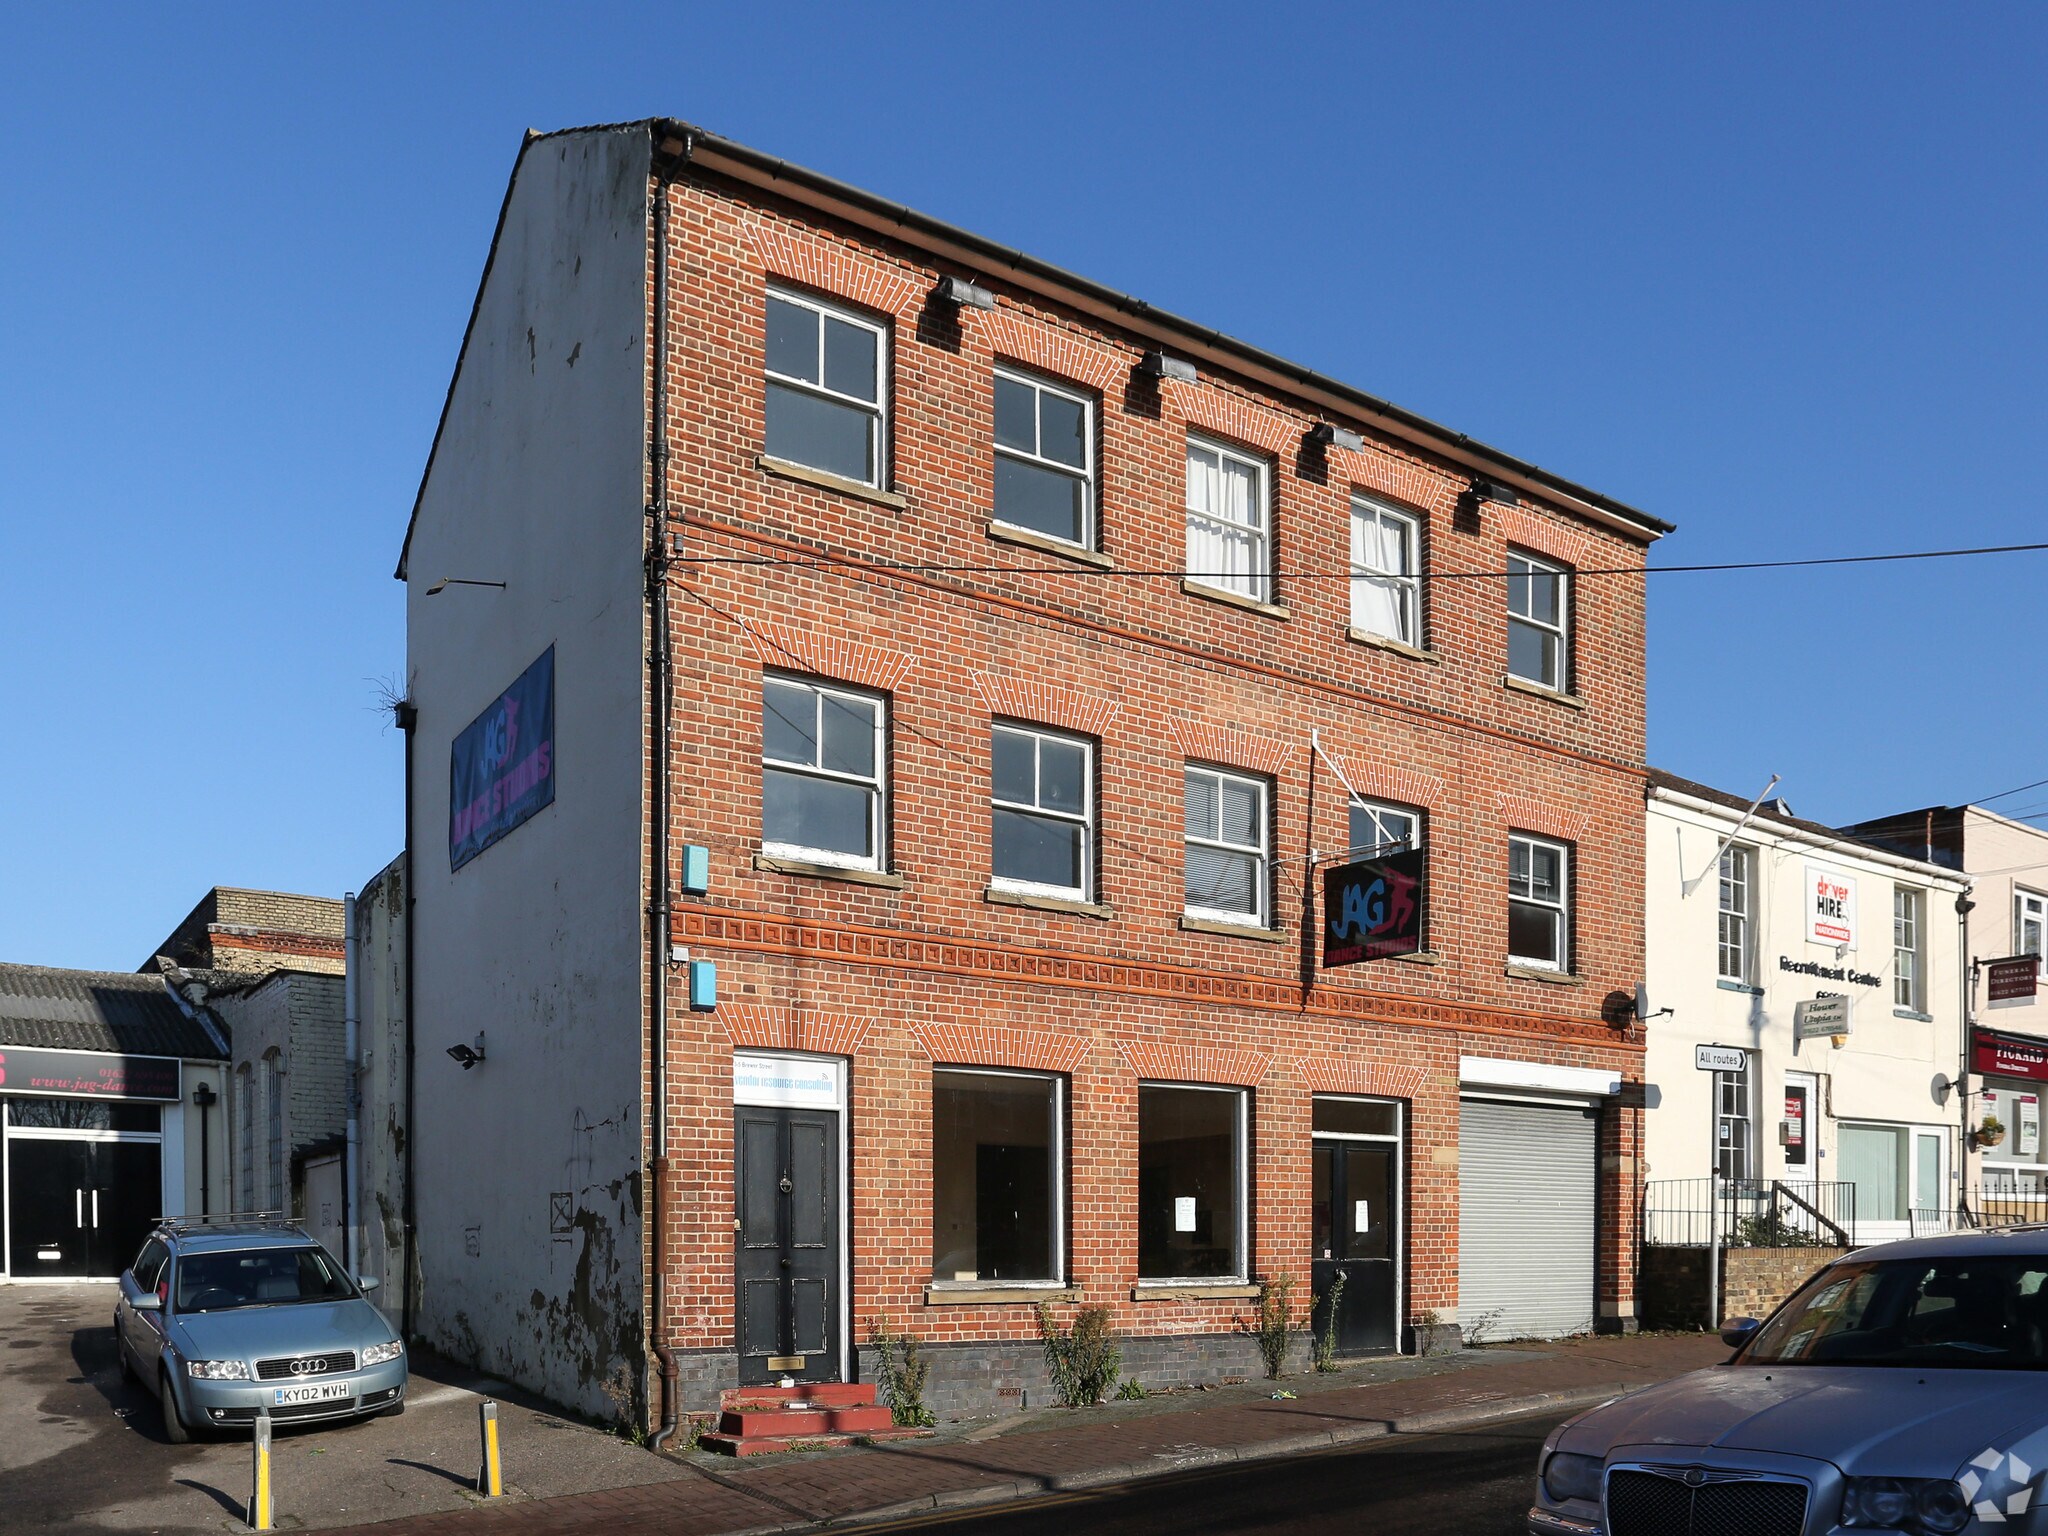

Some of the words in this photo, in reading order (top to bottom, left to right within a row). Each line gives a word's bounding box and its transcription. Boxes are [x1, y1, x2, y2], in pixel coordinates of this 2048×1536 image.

[480, 708, 506, 780] JAG
[1331, 879, 1384, 939] JAG
[1817, 895, 1842, 919] HIRE
[1815, 924, 1850, 940] NATIONWIDE
[1326, 945, 1363, 964] DANCE
[1367, 935, 1417, 957] STUDIOS
[1780, 956, 1845, 981] Recruitment
[1847, 969, 1882, 988] Centre
[1808, 1003, 1839, 1013] Flower
[1803, 1012, 1832, 1025] Utopia
[1700, 1051, 1711, 1063] All
[1713, 1054, 1738, 1065] routes
[734, 1074, 760, 1088] vendor
[761, 1077, 794, 1089] resource
[794, 1079, 833, 1093] consulting
[284, 1387, 319, 1403] KY02
[321, 1384, 347, 1398] WVH
